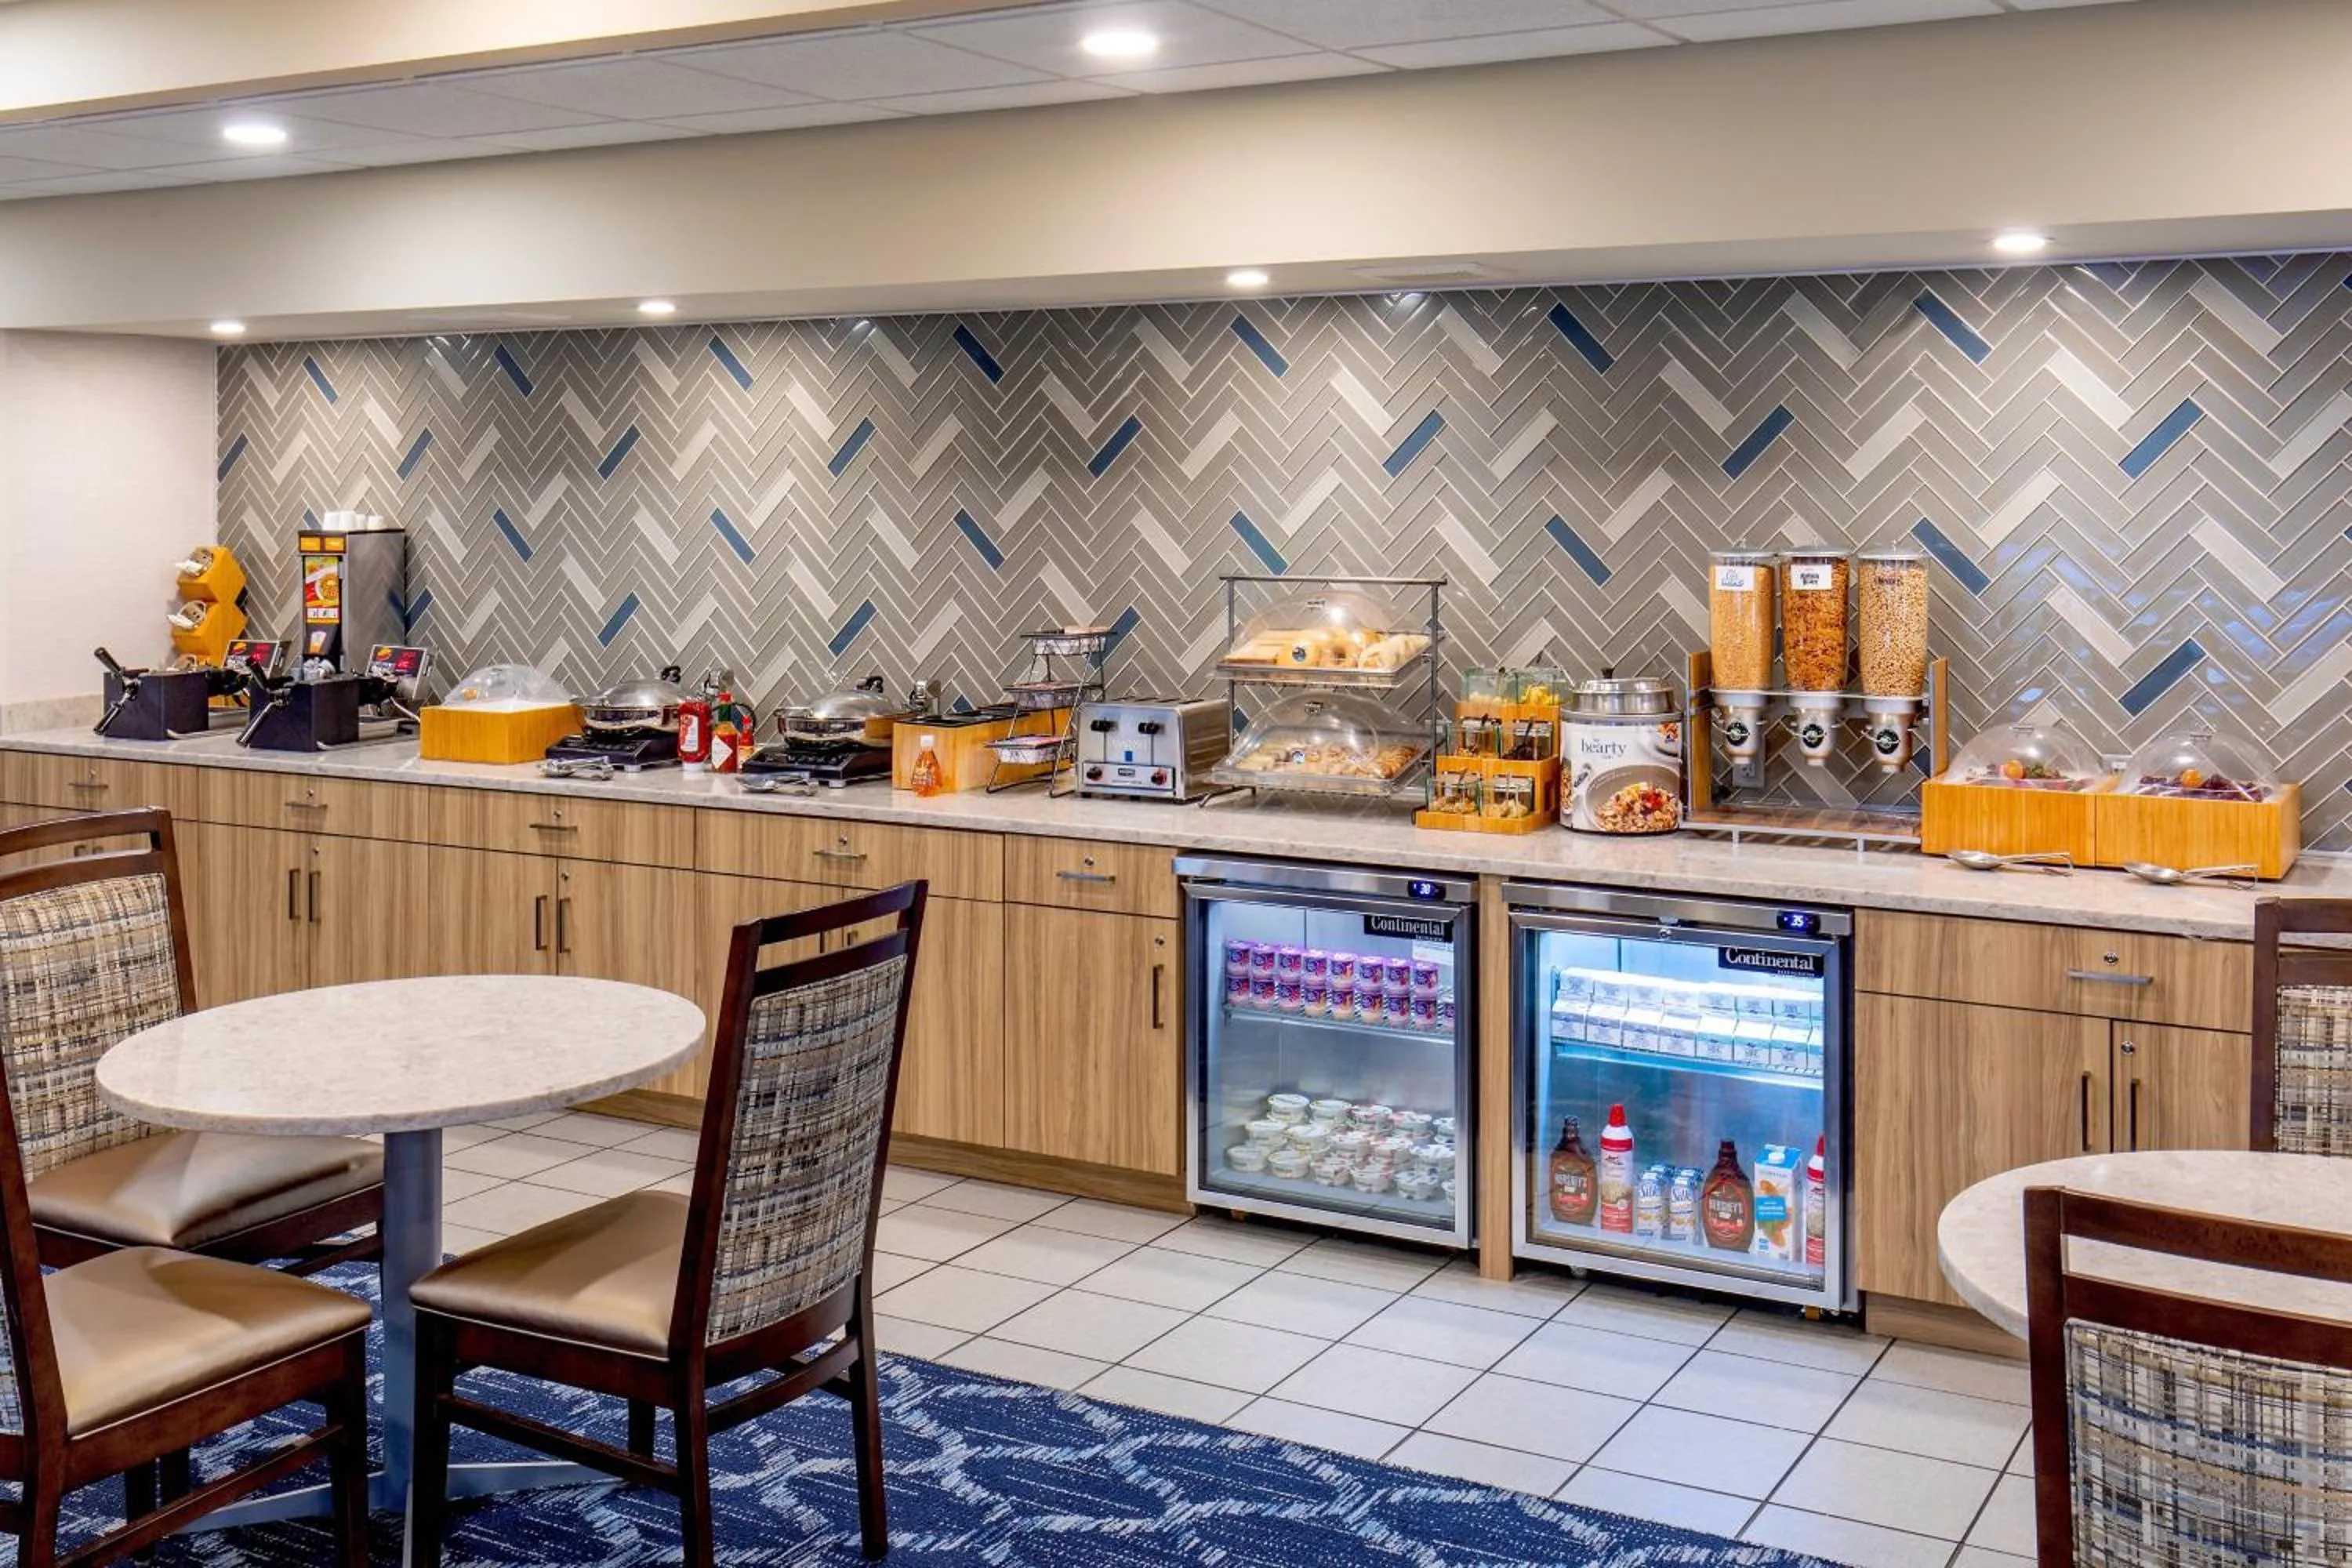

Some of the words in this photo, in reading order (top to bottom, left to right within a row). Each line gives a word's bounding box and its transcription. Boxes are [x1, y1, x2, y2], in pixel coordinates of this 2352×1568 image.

[1582, 739, 1627, 755] hearty
[1370, 915, 1444, 935] Continental
[1791, 914, 1804, 927] 35
[1726, 947, 1814, 971] Continental
